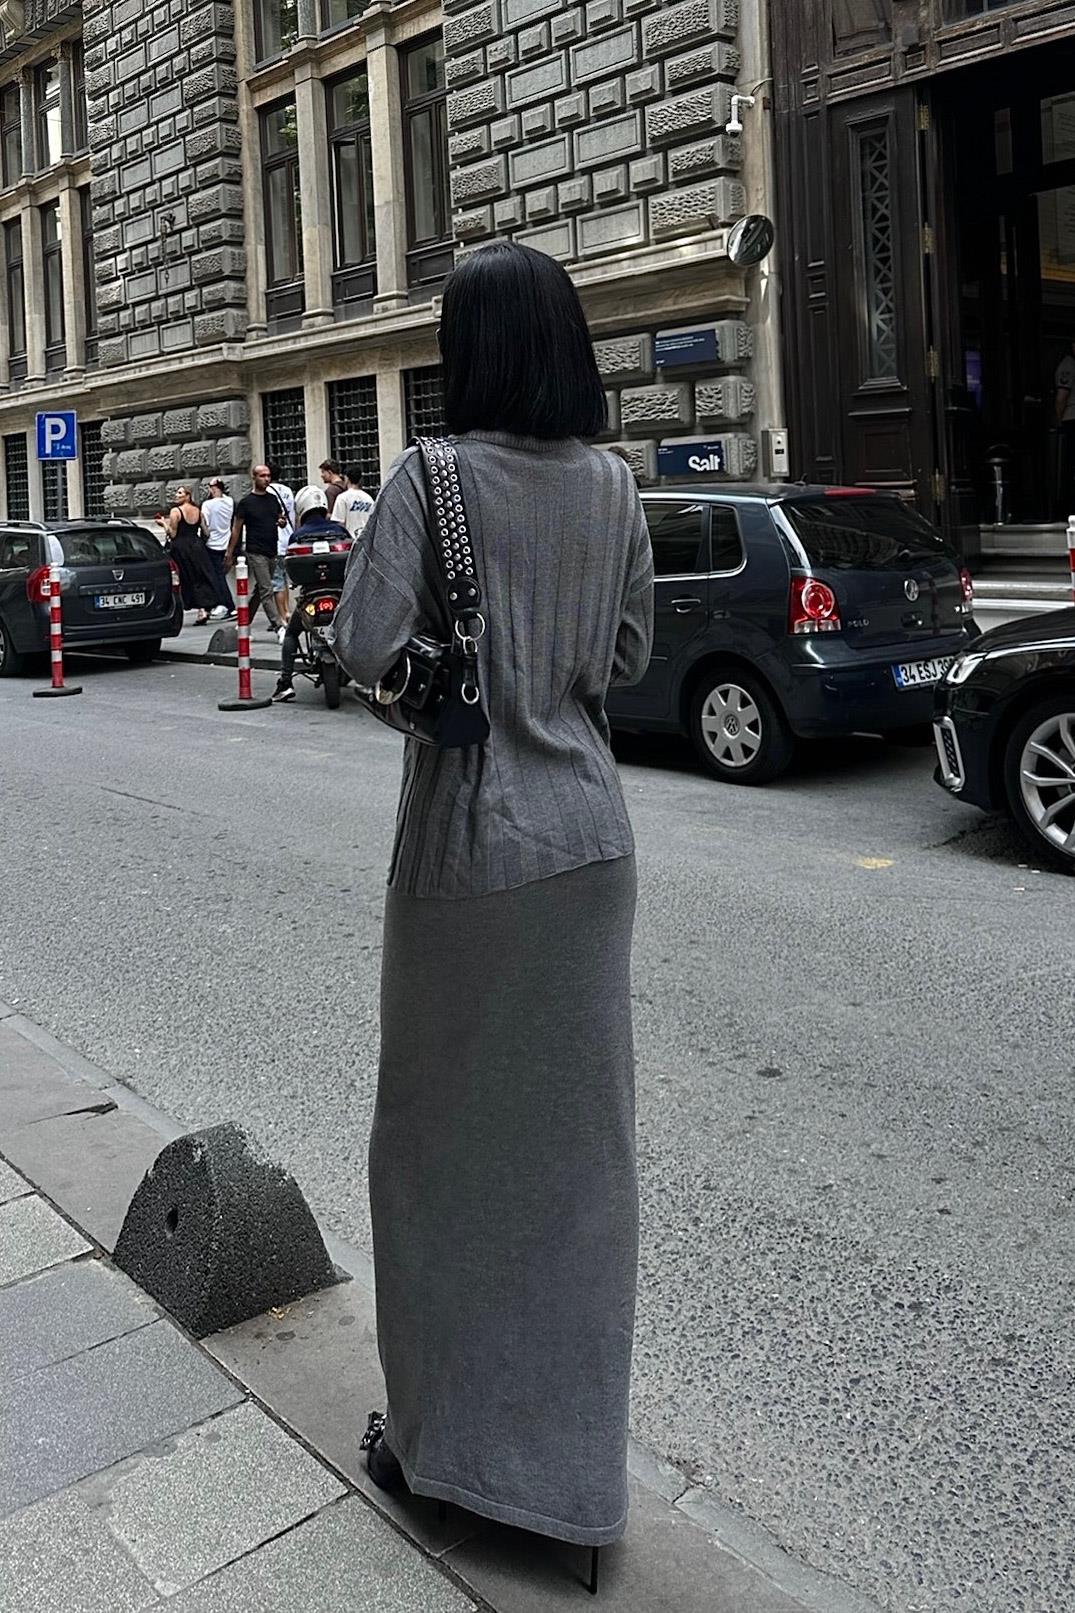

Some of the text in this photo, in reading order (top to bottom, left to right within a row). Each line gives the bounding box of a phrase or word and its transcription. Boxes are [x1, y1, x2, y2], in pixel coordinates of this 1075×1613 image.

[45, 418, 66, 453] P
[688, 454, 720, 471] Salt
[100, 596, 110, 606] 34
[131, 594, 144, 603] 491
[901, 666, 916, 683] 34
[916, 661, 937, 680] ESJ
